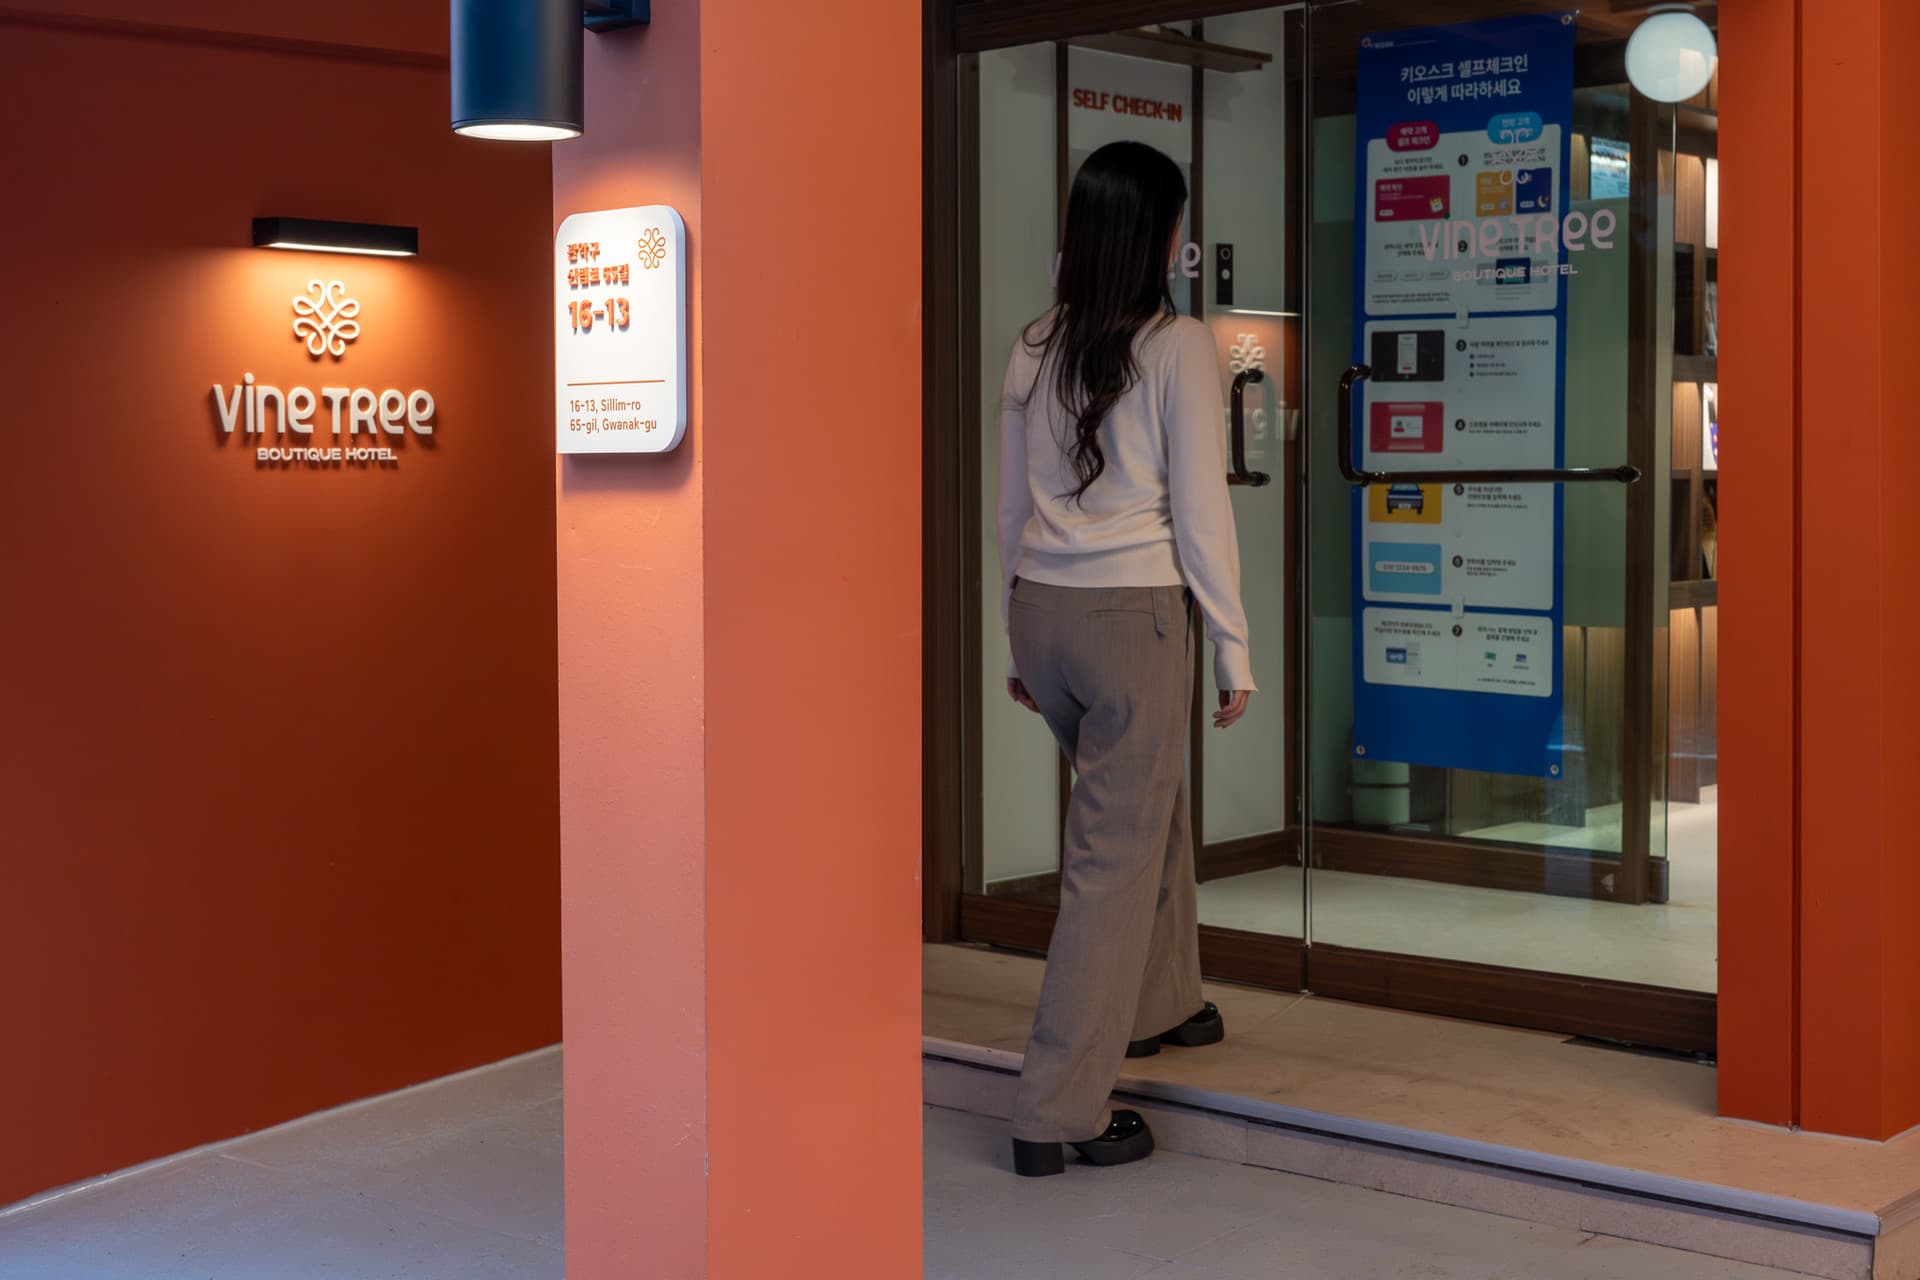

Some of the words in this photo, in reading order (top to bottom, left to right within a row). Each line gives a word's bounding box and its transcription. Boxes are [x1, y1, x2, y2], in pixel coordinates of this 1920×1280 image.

[1400, 63, 1455, 83] 키오스크
[1457, 53, 1528, 78] 셀프체크인
[1407, 83, 1448, 105] 이렇게
[1450, 78, 1522, 102] 따라하세요
[1073, 88, 1110, 112] SELF
[1112, 94, 1183, 123] CHECK-IN
[1452, 266, 1527, 281] BOUTIQUE
[1529, 264, 1578, 277] HOTEL
[567, 297, 631, 331] 16-13
[569, 399, 599, 414] 16-13,
[601, 398, 641, 412] Sillim-ro
[569, 418, 600, 434] 65-gil,
[602, 417, 657, 433] Gwanak-gu
[257, 447, 342, 462] BOUTIQUE
[344, 447, 397, 461] HOTEL
